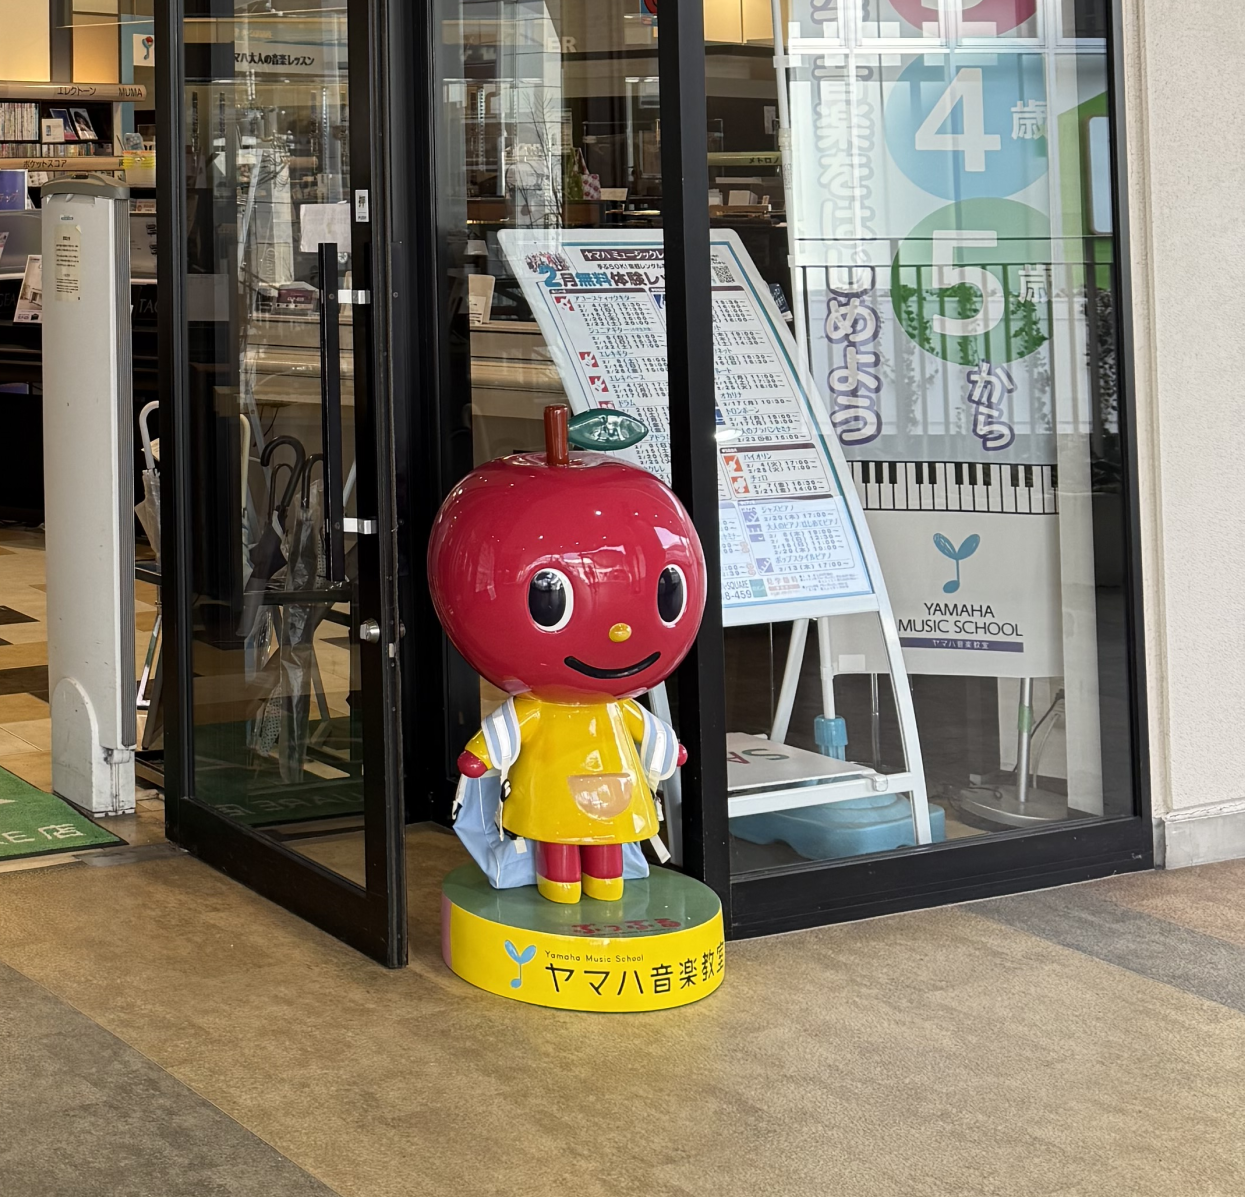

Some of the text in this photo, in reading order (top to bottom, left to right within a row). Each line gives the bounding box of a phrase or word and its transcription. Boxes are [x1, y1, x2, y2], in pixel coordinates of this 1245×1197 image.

[57, 87, 97, 96] エレクトーン
[23, 159, 67, 168] ポケットスコア
[923, 602, 995, 619] YAMAHA
[898, 619, 1024, 636] MUSIC SCHOOL
[932, 639, 990, 650] ヤマハ音楽教室
[544, 949, 644, 962] Yamaha Music School
[545, 940, 725, 995] ヤマハ音楽教室
